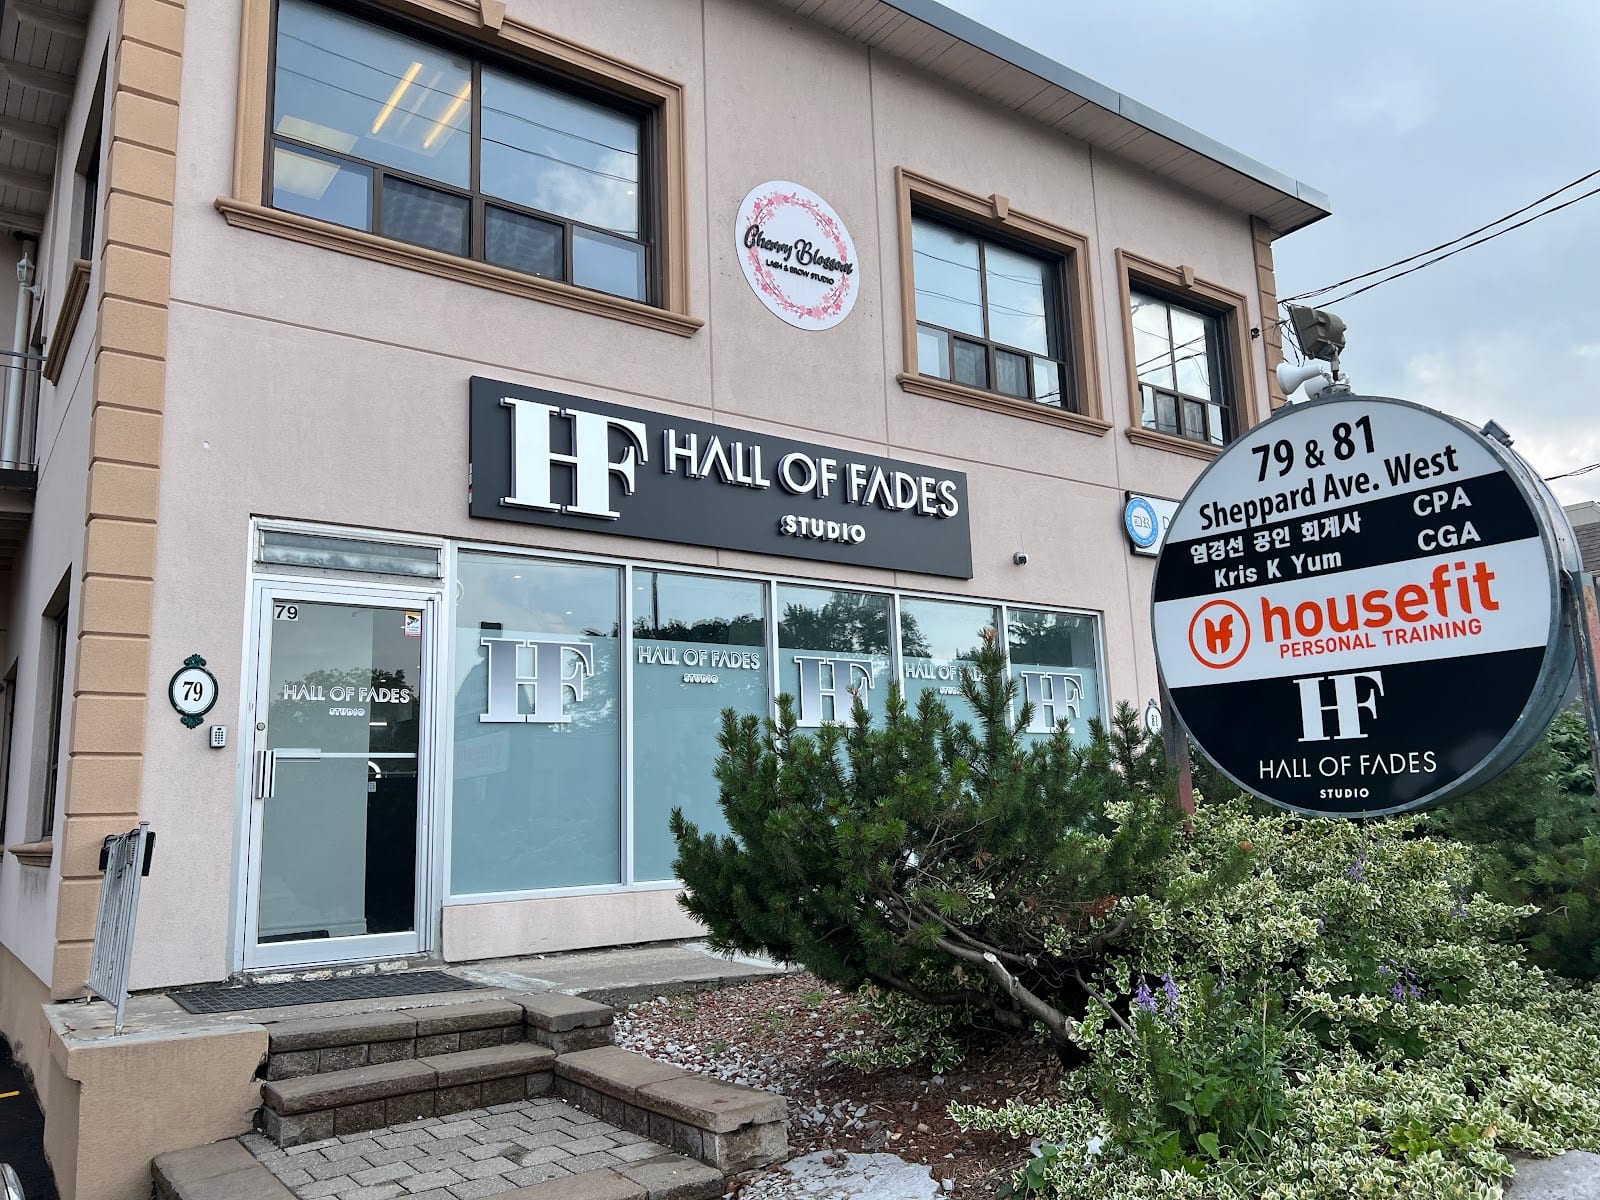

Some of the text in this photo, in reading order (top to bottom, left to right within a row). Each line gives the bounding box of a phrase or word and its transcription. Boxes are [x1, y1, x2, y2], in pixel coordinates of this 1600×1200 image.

[744, 224, 853, 275] Cherry Blossom
[766, 259, 783, 270] LASH
[790, 266, 809, 278] BROW
[811, 273, 834, 285] STUDIO
[500, 397, 649, 521] HF
[1251, 415, 1376, 483] 79 & 81
[663, 428, 960, 519] HALL OF FADES
[1199, 478, 1316, 531] Sheppard
[1323, 472, 1380, 503] Ave.
[1384, 444, 1460, 488] West
[1413, 486, 1472, 517] CPA
[780, 514, 866, 545] STUDIO
[1190, 510, 1362, 564] 염경선 공인 회계사
[1417, 521, 1481, 552] CGA
[1214, 551, 1343, 588] Kris K Yum
[275, 604, 298, 620] 79
[1261, 561, 1500, 644] housefit
[1280, 618, 1483, 659] PERSONAL TRAINING
[638, 645, 761, 670] HALL OF FADES
[905, 662, 936, 680] HALL
[938, 664, 957, 680] OF
[182, 681, 204, 702] 79
[283, 684, 410, 704] HALL OF FADES
[479, 637, 594, 723] HF
[682, 673, 719, 684] STUDIO
[794, 655, 875, 728] HF
[328, 707, 366, 717] STUDIO
[1021, 670, 1084, 733] HF
[1292, 670, 1385, 743] HF
[1259, 751, 1438, 780] HALL OF FADES
[1319, 787, 1370, 799] STUDIO
